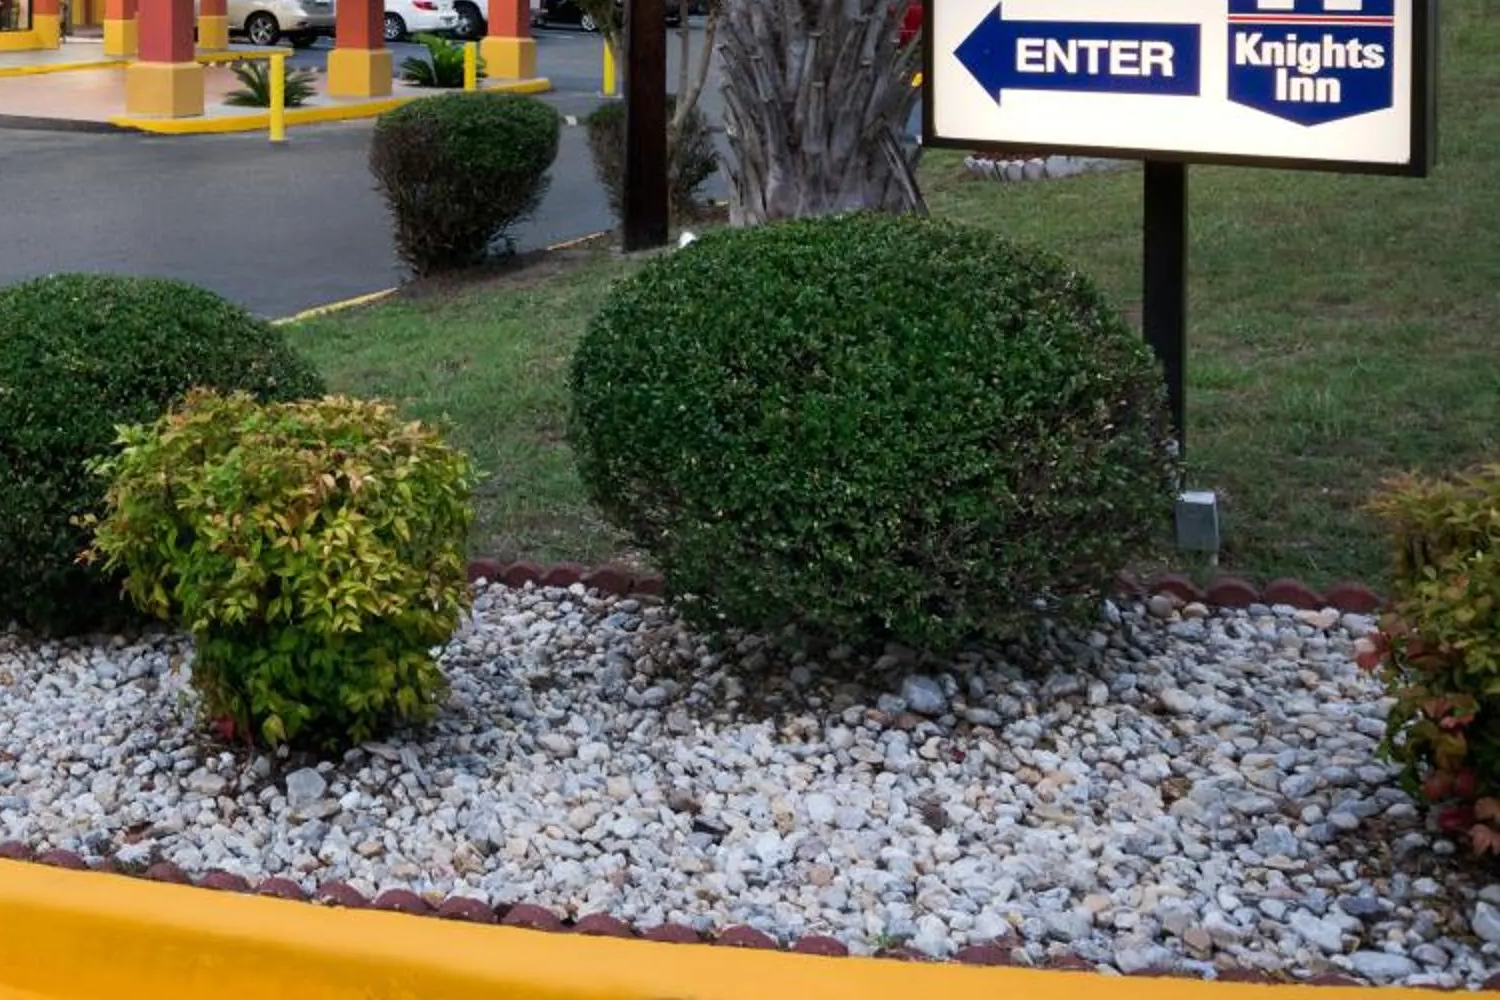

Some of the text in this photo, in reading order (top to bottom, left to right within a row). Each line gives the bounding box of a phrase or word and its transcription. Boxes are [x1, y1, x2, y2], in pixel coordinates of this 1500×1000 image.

[1016, 38, 1174, 77] ENTER
[1235, 33, 1385, 74] Knights
[1276, 70, 1342, 103] Inn
